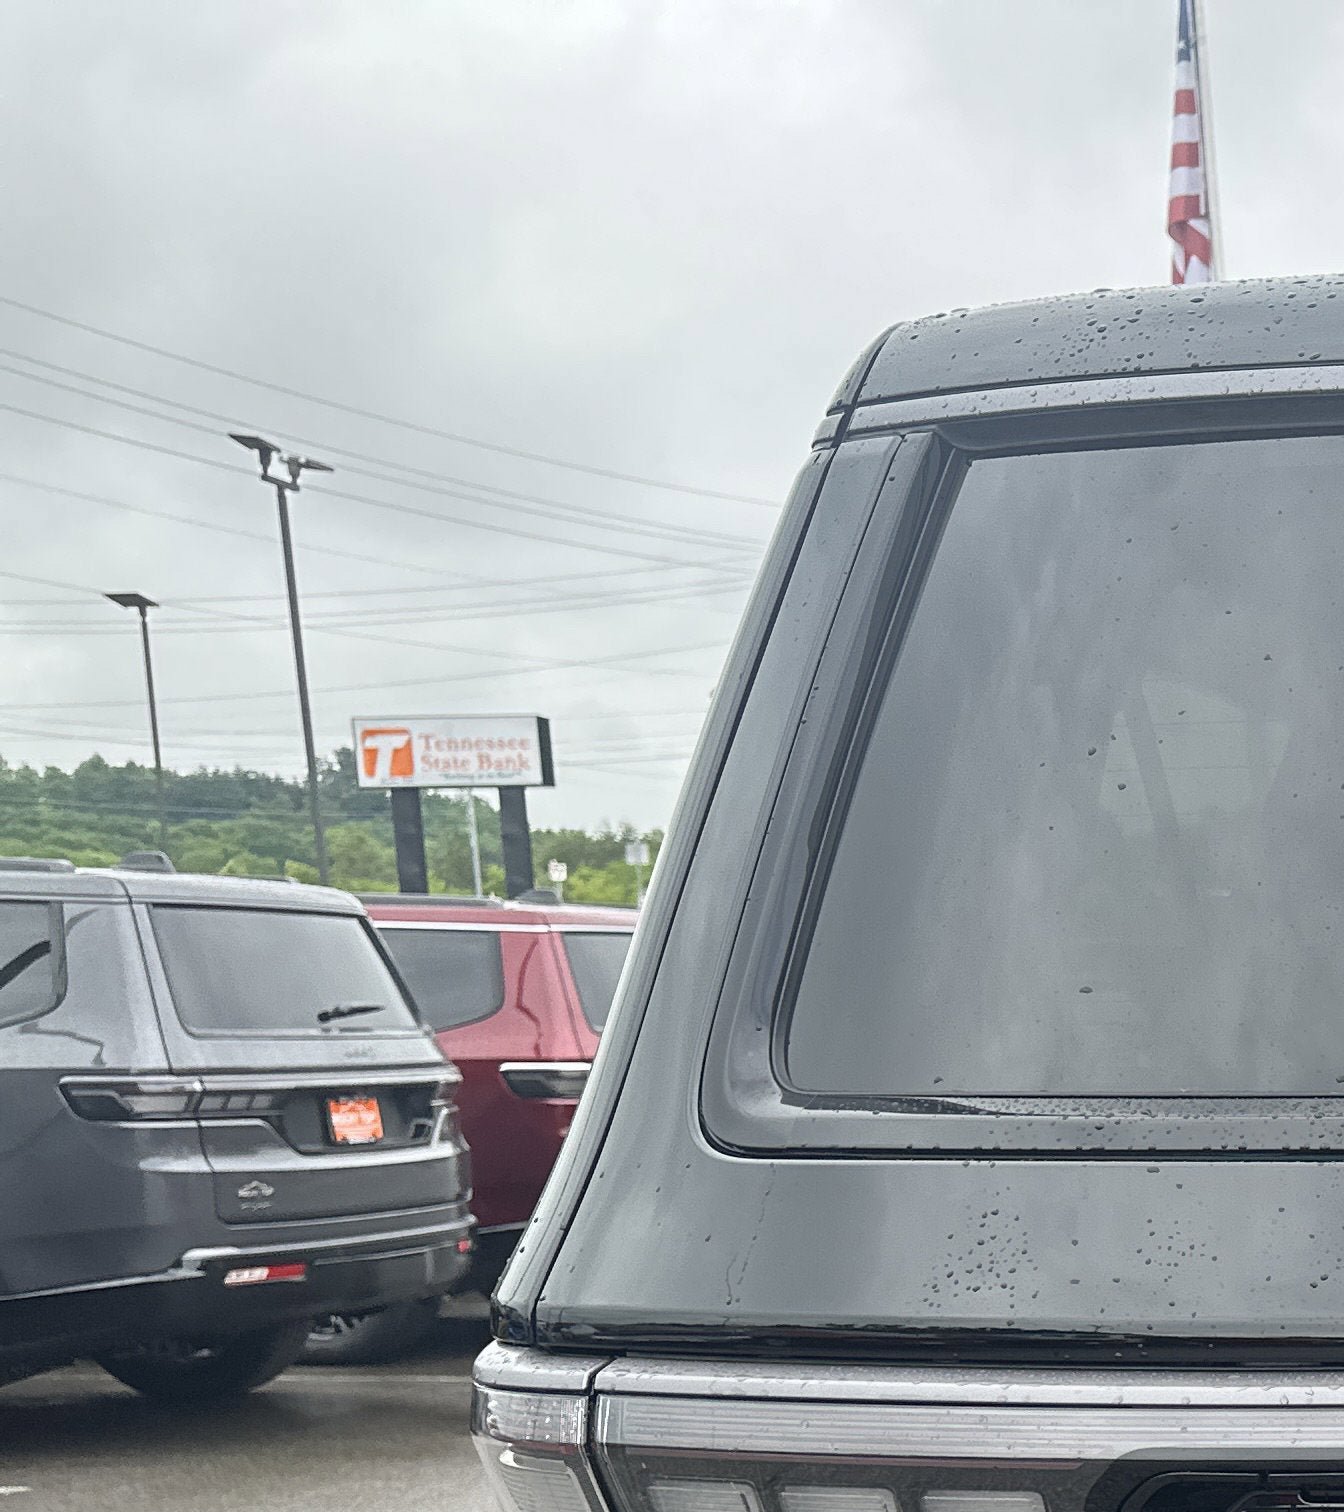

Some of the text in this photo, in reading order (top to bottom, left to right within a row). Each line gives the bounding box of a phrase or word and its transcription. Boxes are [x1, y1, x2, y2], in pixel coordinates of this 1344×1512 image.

[418, 733, 530, 752] Tennessee
[420, 752, 530, 771] State Bank
